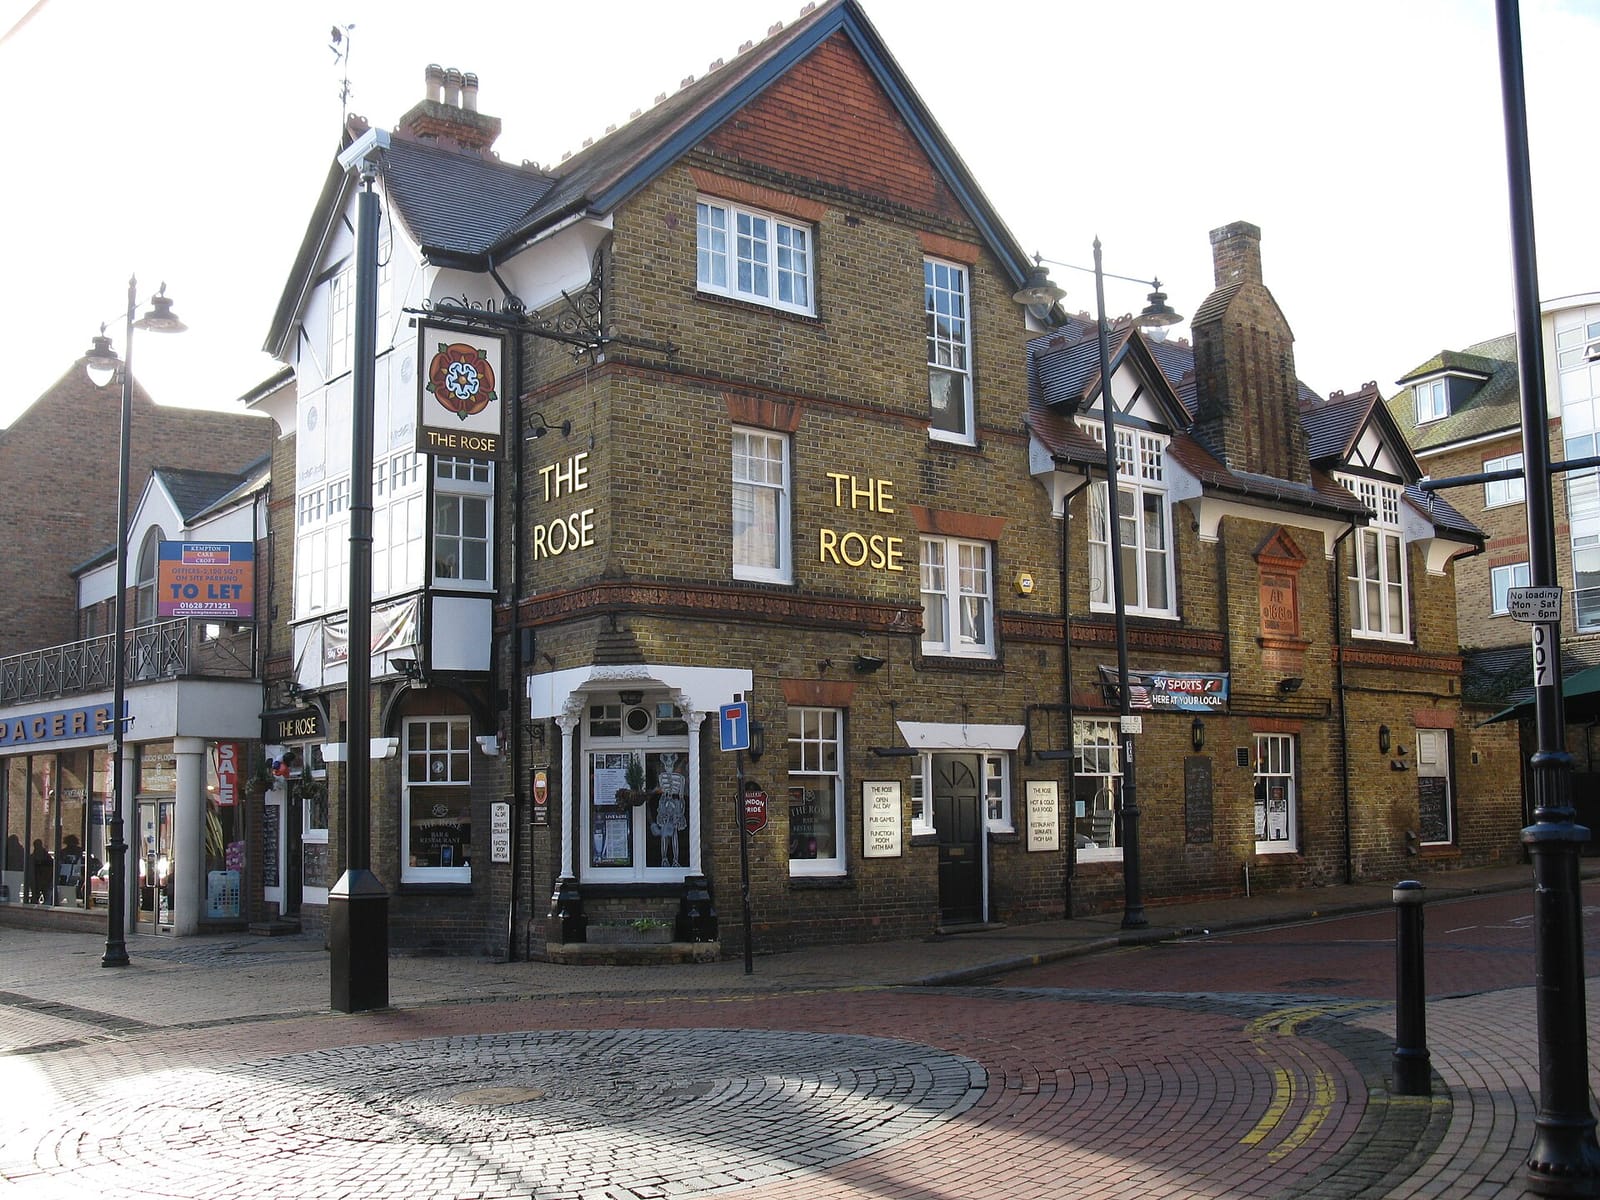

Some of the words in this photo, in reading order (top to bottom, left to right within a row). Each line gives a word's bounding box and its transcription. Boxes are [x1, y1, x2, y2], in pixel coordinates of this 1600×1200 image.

[427, 432, 457, 448] THE
[460, 436, 496, 452] ROSE
[539, 452, 589, 502] THE
[826, 472, 894, 514] THE
[534, 508, 595, 561] ROSE
[820, 528, 904, 571] ROSE
[170, 583, 199, 599] TO
[207, 584, 243, 599] LET
[1510, 592, 1522, 600] No
[1525, 591, 1559, 600] loading
[1512, 601, 1531, 609] Mon
[1540, 600, 1556, 608] Sat
[1512, 610, 1529, 618] 8am
[1538, 610, 1558, 619] 6pm
[1535, 626, 1546, 685] 007
[1154, 676, 1167, 691] sky
[1167, 679, 1202, 691] SPORTS
[1152, 694, 1170, 704] HERE
[1170, 696, 1177, 704] AT
[1179, 696, 1199, 705] YOUR
[1200, 696, 1222, 705] LOCAL
[278, 721, 294, 738] THE
[295, 717, 316, 735] ROSE
[219, 745, 234, 803] SALE
[744, 799, 764, 807] NDON
